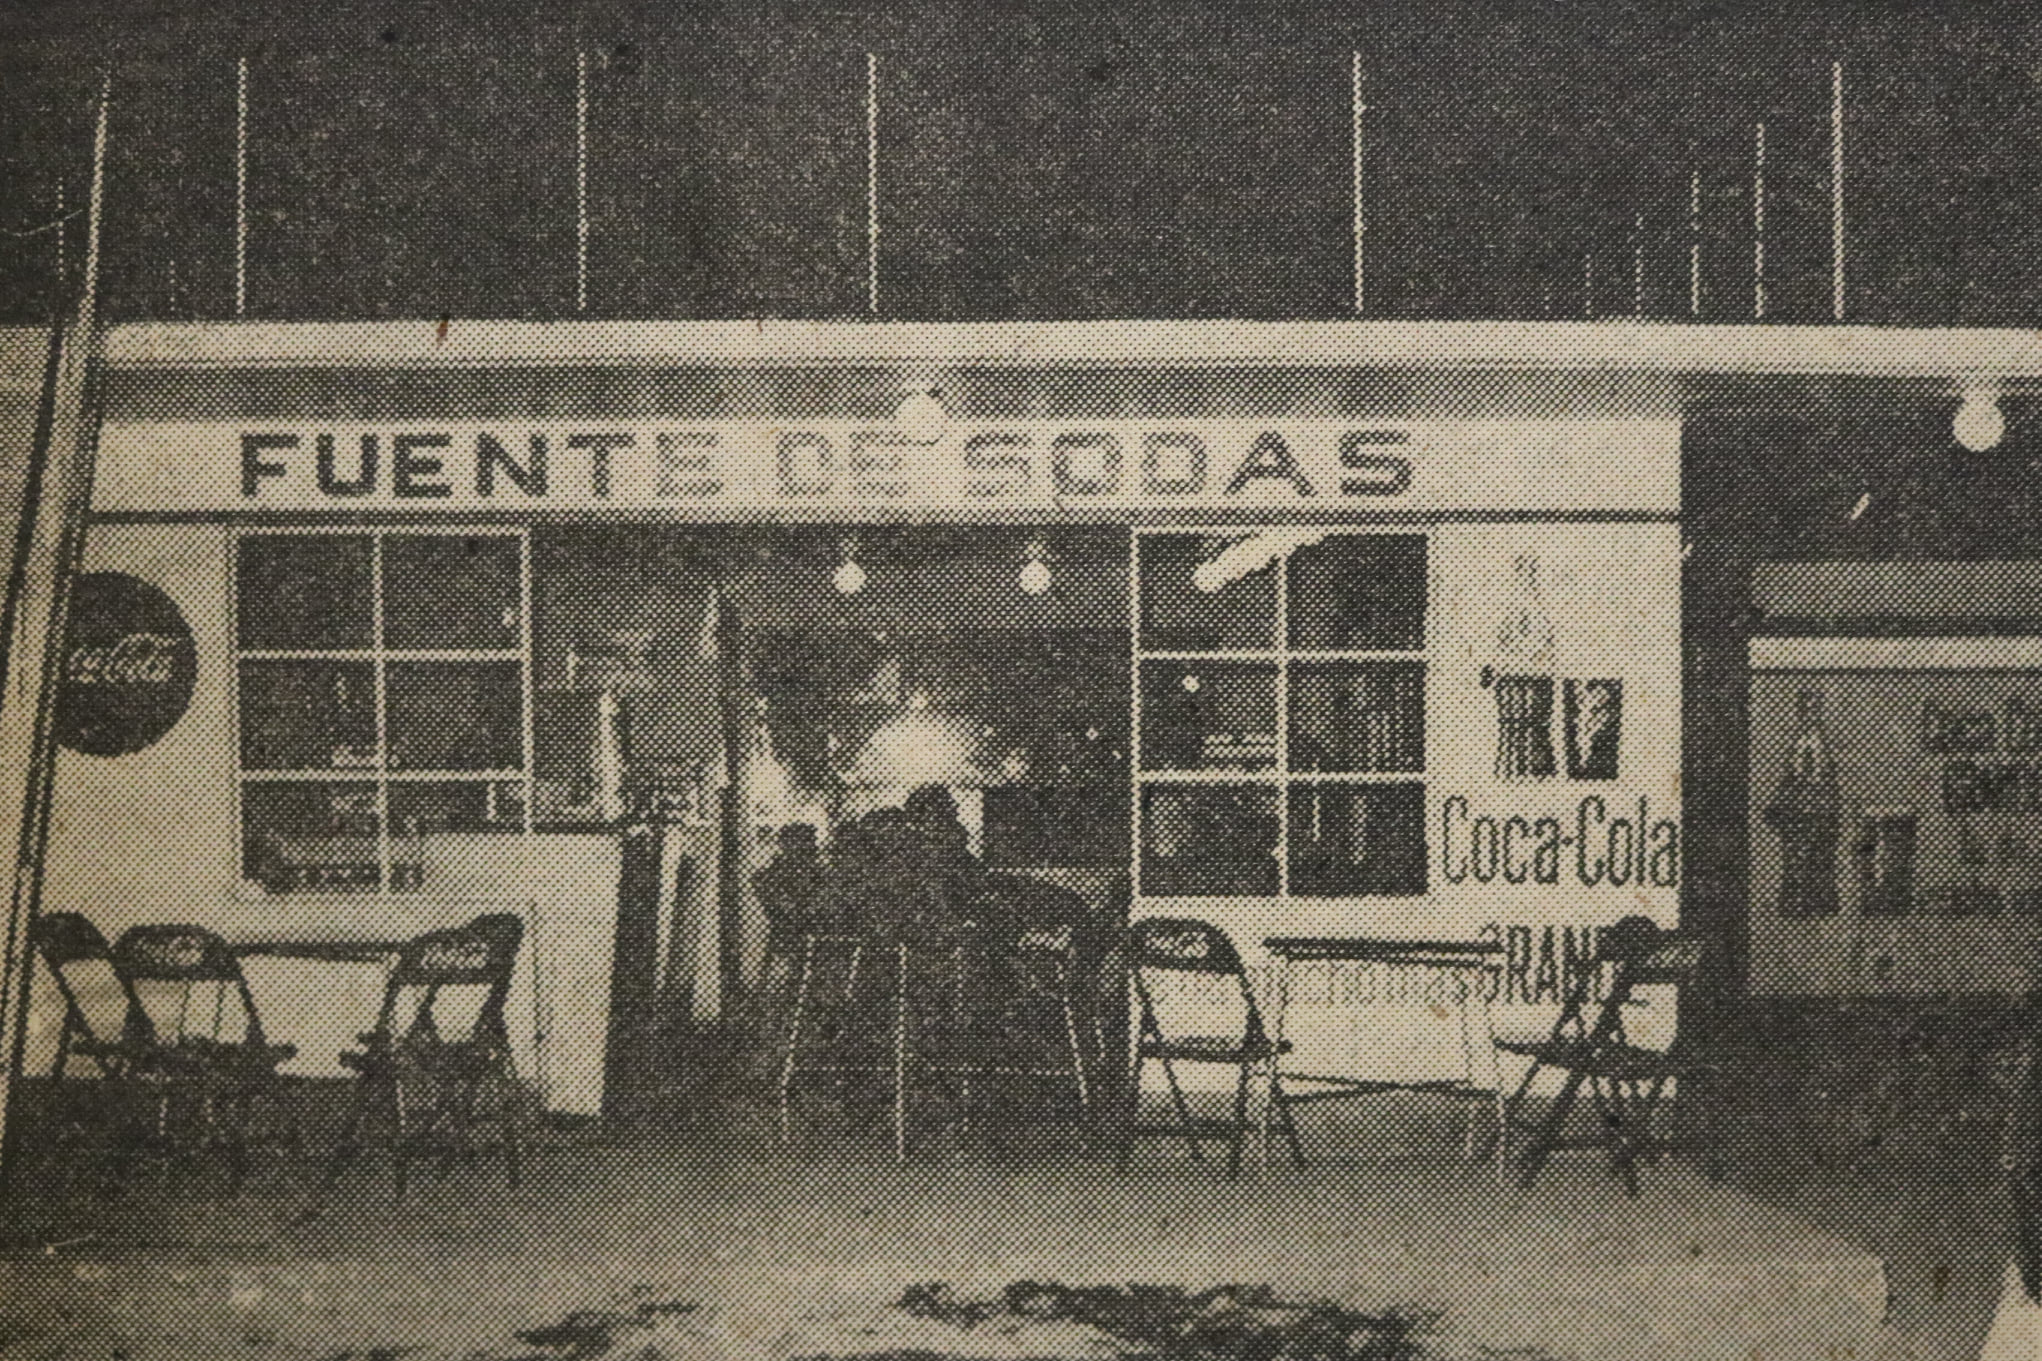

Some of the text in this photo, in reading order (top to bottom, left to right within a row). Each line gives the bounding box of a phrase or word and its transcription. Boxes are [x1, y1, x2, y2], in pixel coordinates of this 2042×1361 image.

[240, 429, 1412, 499] FUENTE DE SODAS
[1443, 794, 1679, 888] Coca-Cola
